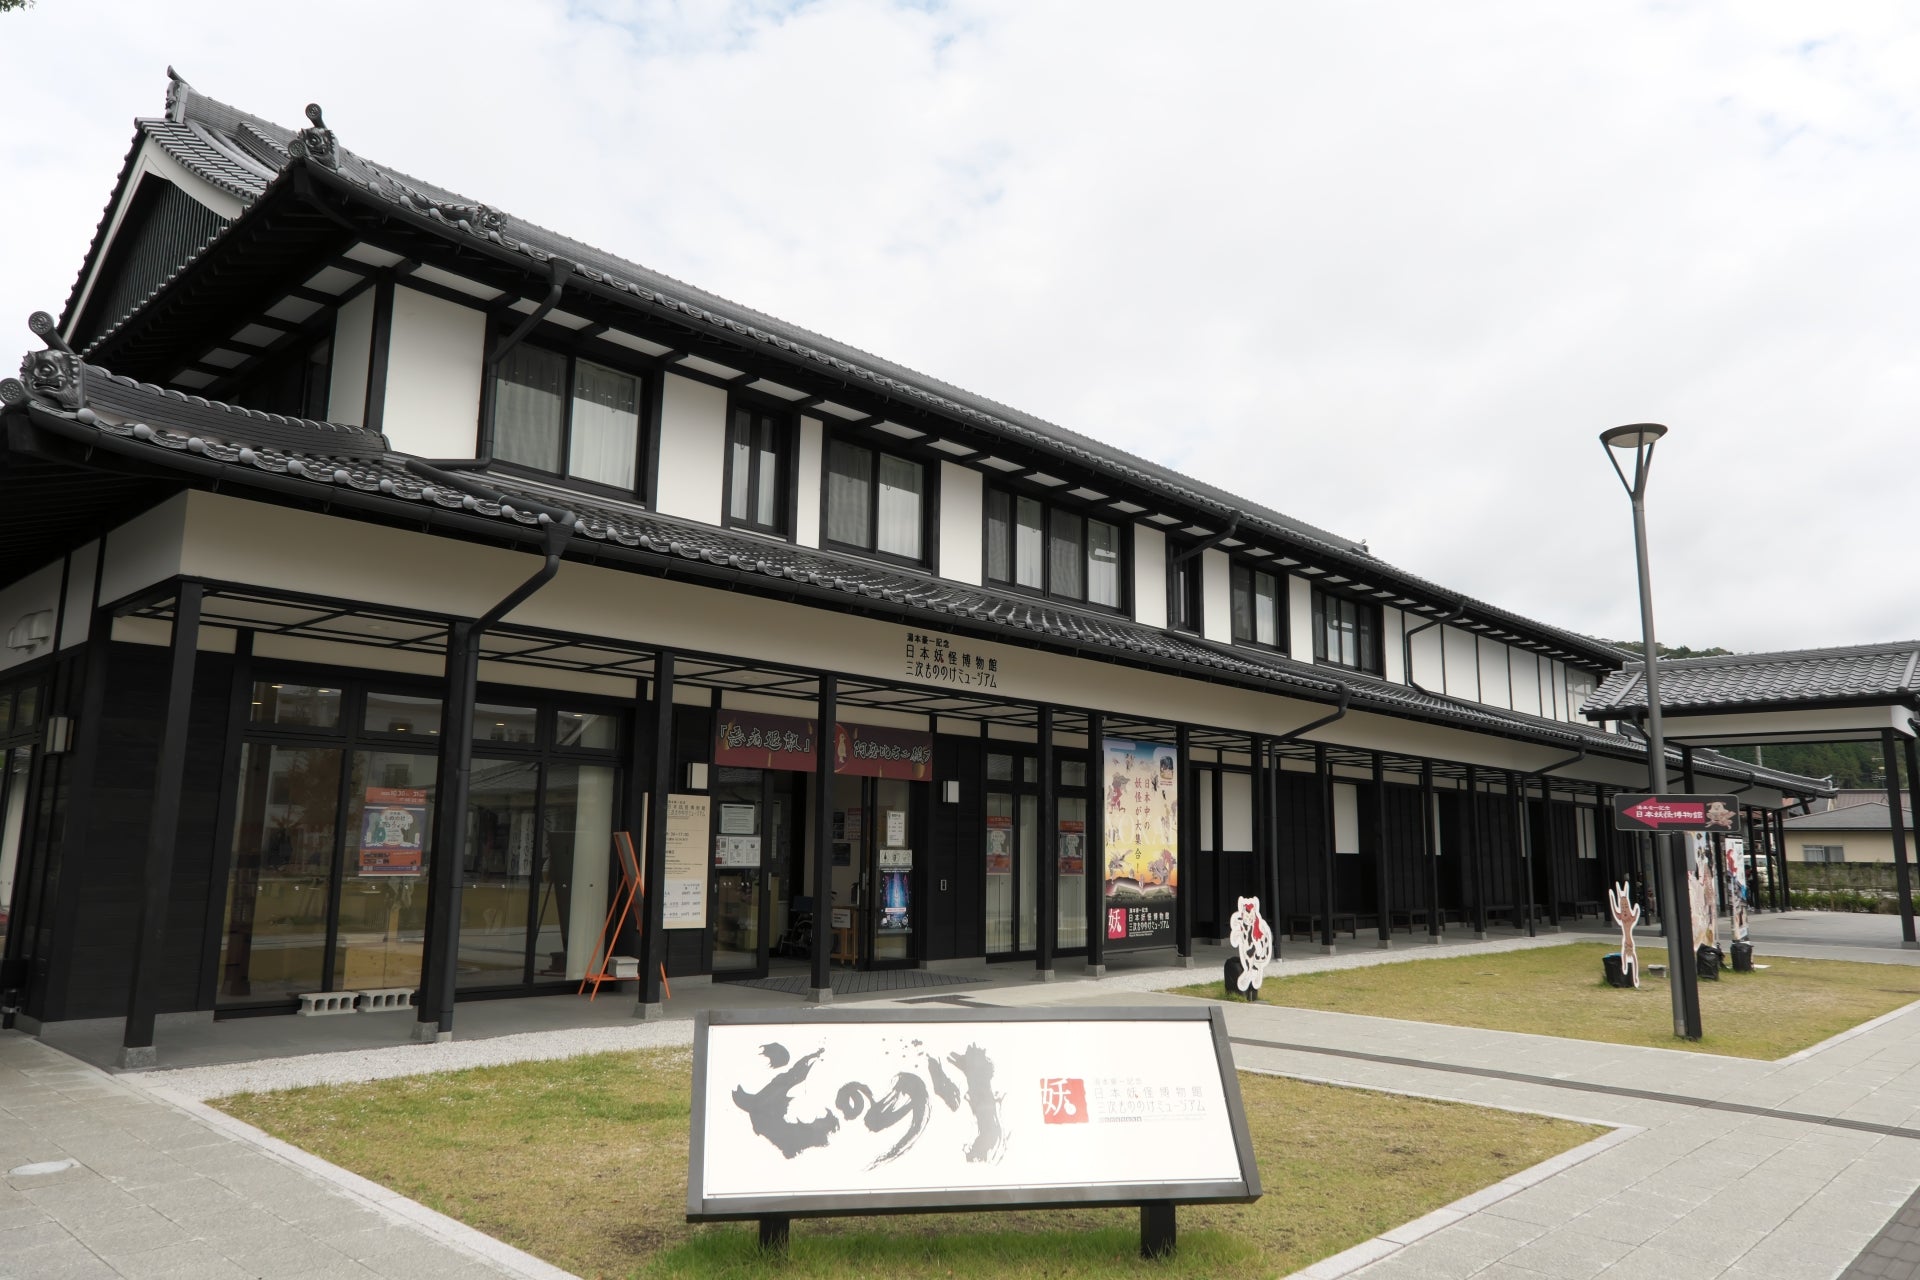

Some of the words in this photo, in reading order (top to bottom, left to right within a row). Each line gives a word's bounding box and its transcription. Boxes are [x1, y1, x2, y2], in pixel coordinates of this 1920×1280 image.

[906, 644, 997, 672] 日本妖怪博物館
[906, 661, 997, 688] 三次もののけミュージアム
[1636, 810, 1703, 818] 日本妖怪博物館
[1108, 908, 1122, 932] 妖
[1040, 1078, 1077, 1116] 妖
[1094, 1086, 1203, 1099] 日本妖怪博物館
[1097, 1100, 1206, 1114] 三次もののけミュージアム
